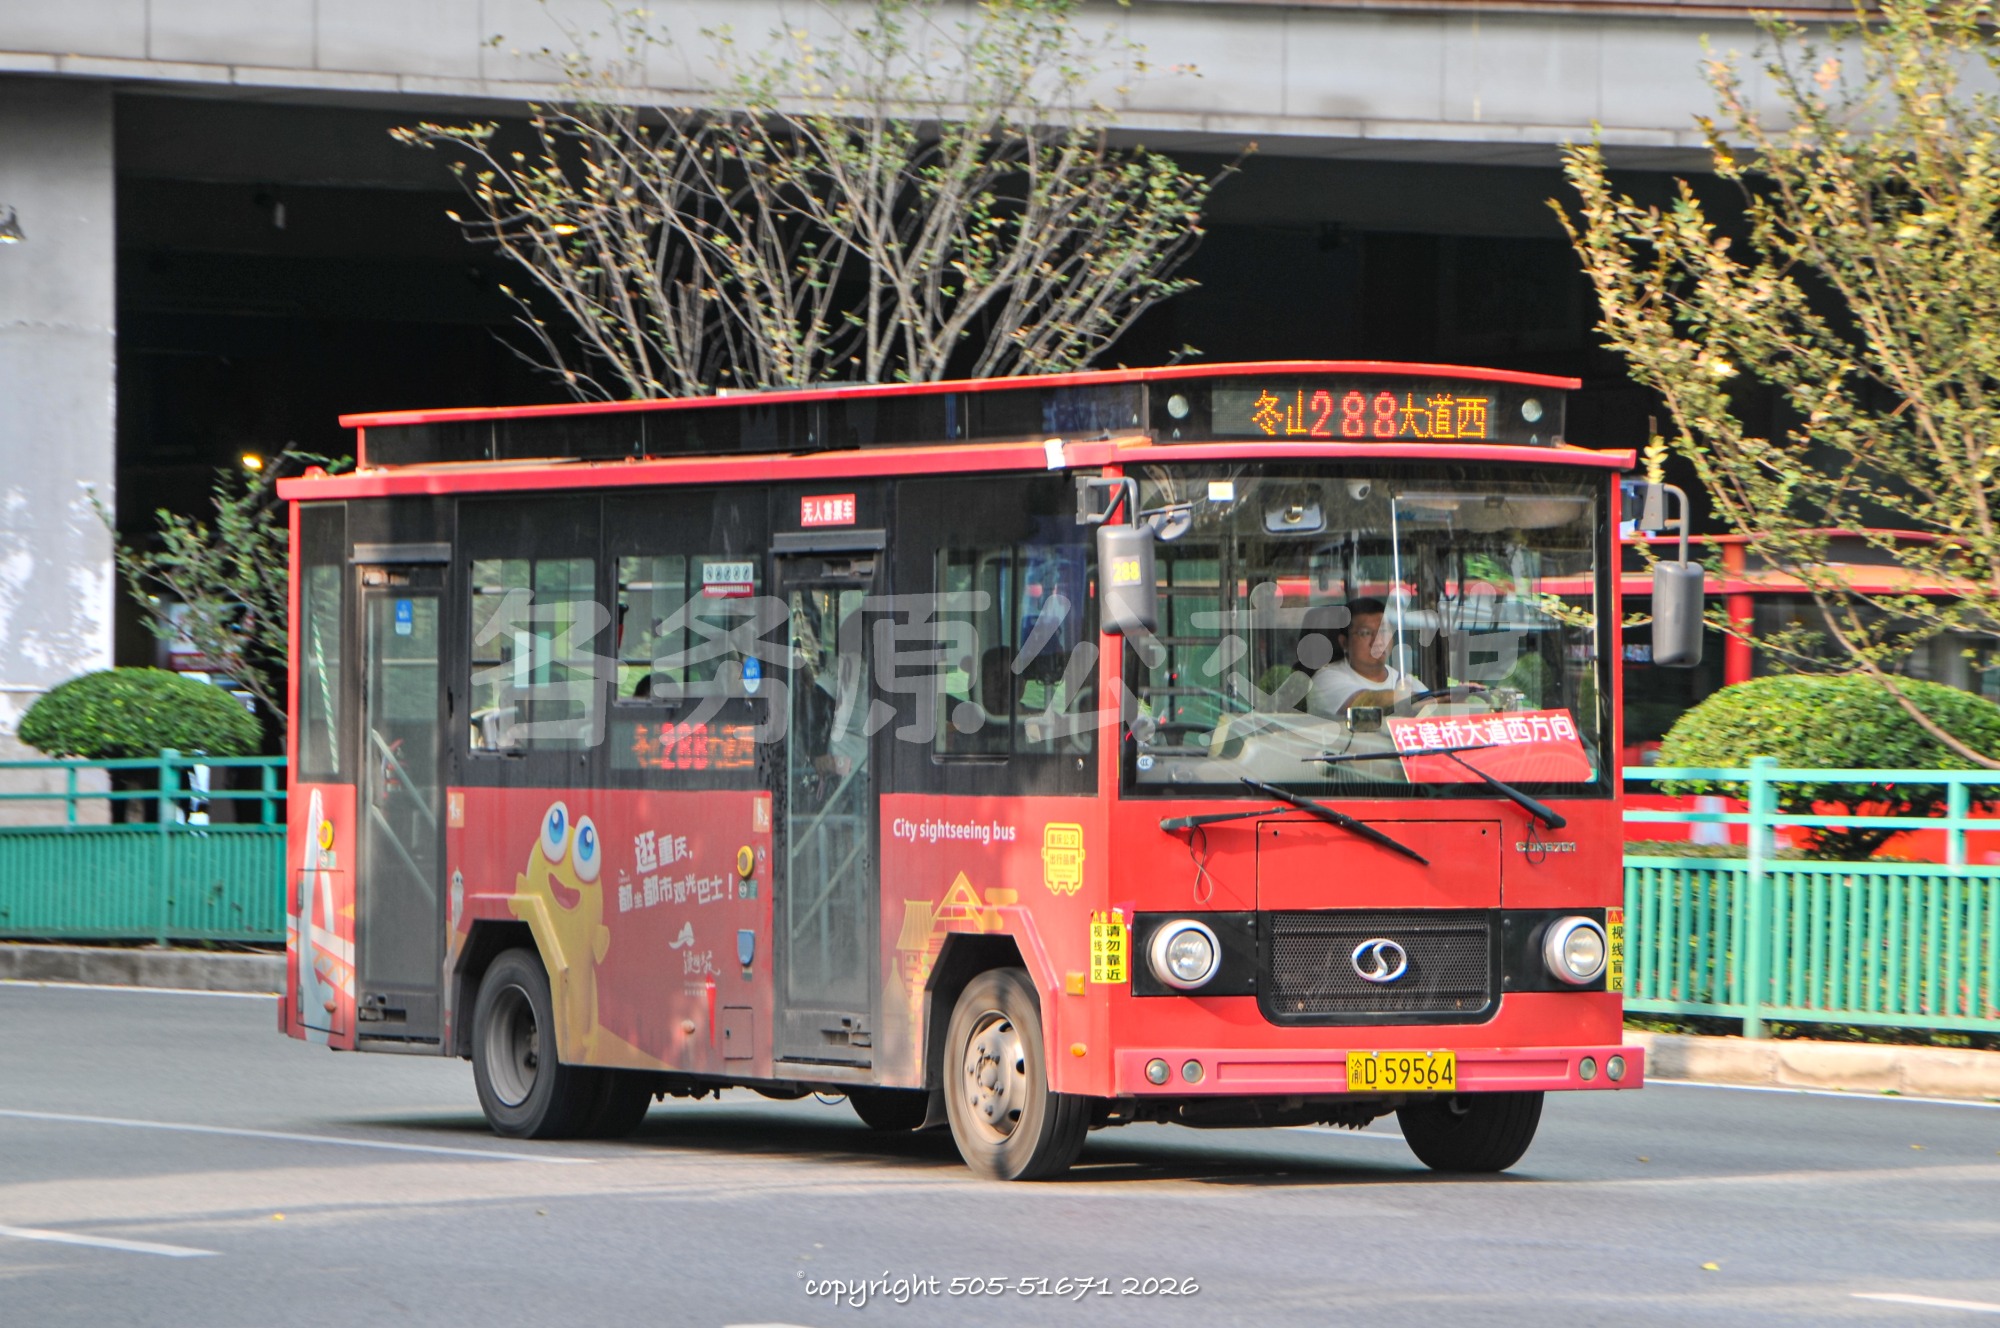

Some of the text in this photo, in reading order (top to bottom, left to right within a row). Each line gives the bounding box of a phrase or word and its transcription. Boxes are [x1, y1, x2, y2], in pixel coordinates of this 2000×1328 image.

[1112, 561, 1140, 583] 288
[1395, 714, 1577, 751] 往建桥大道西方向
[893, 818, 1016, 845] City sightseeing bus
[1094, 926, 1102, 980] 视线盲区
[1106, 925, 1120, 981] 请勿靠近
